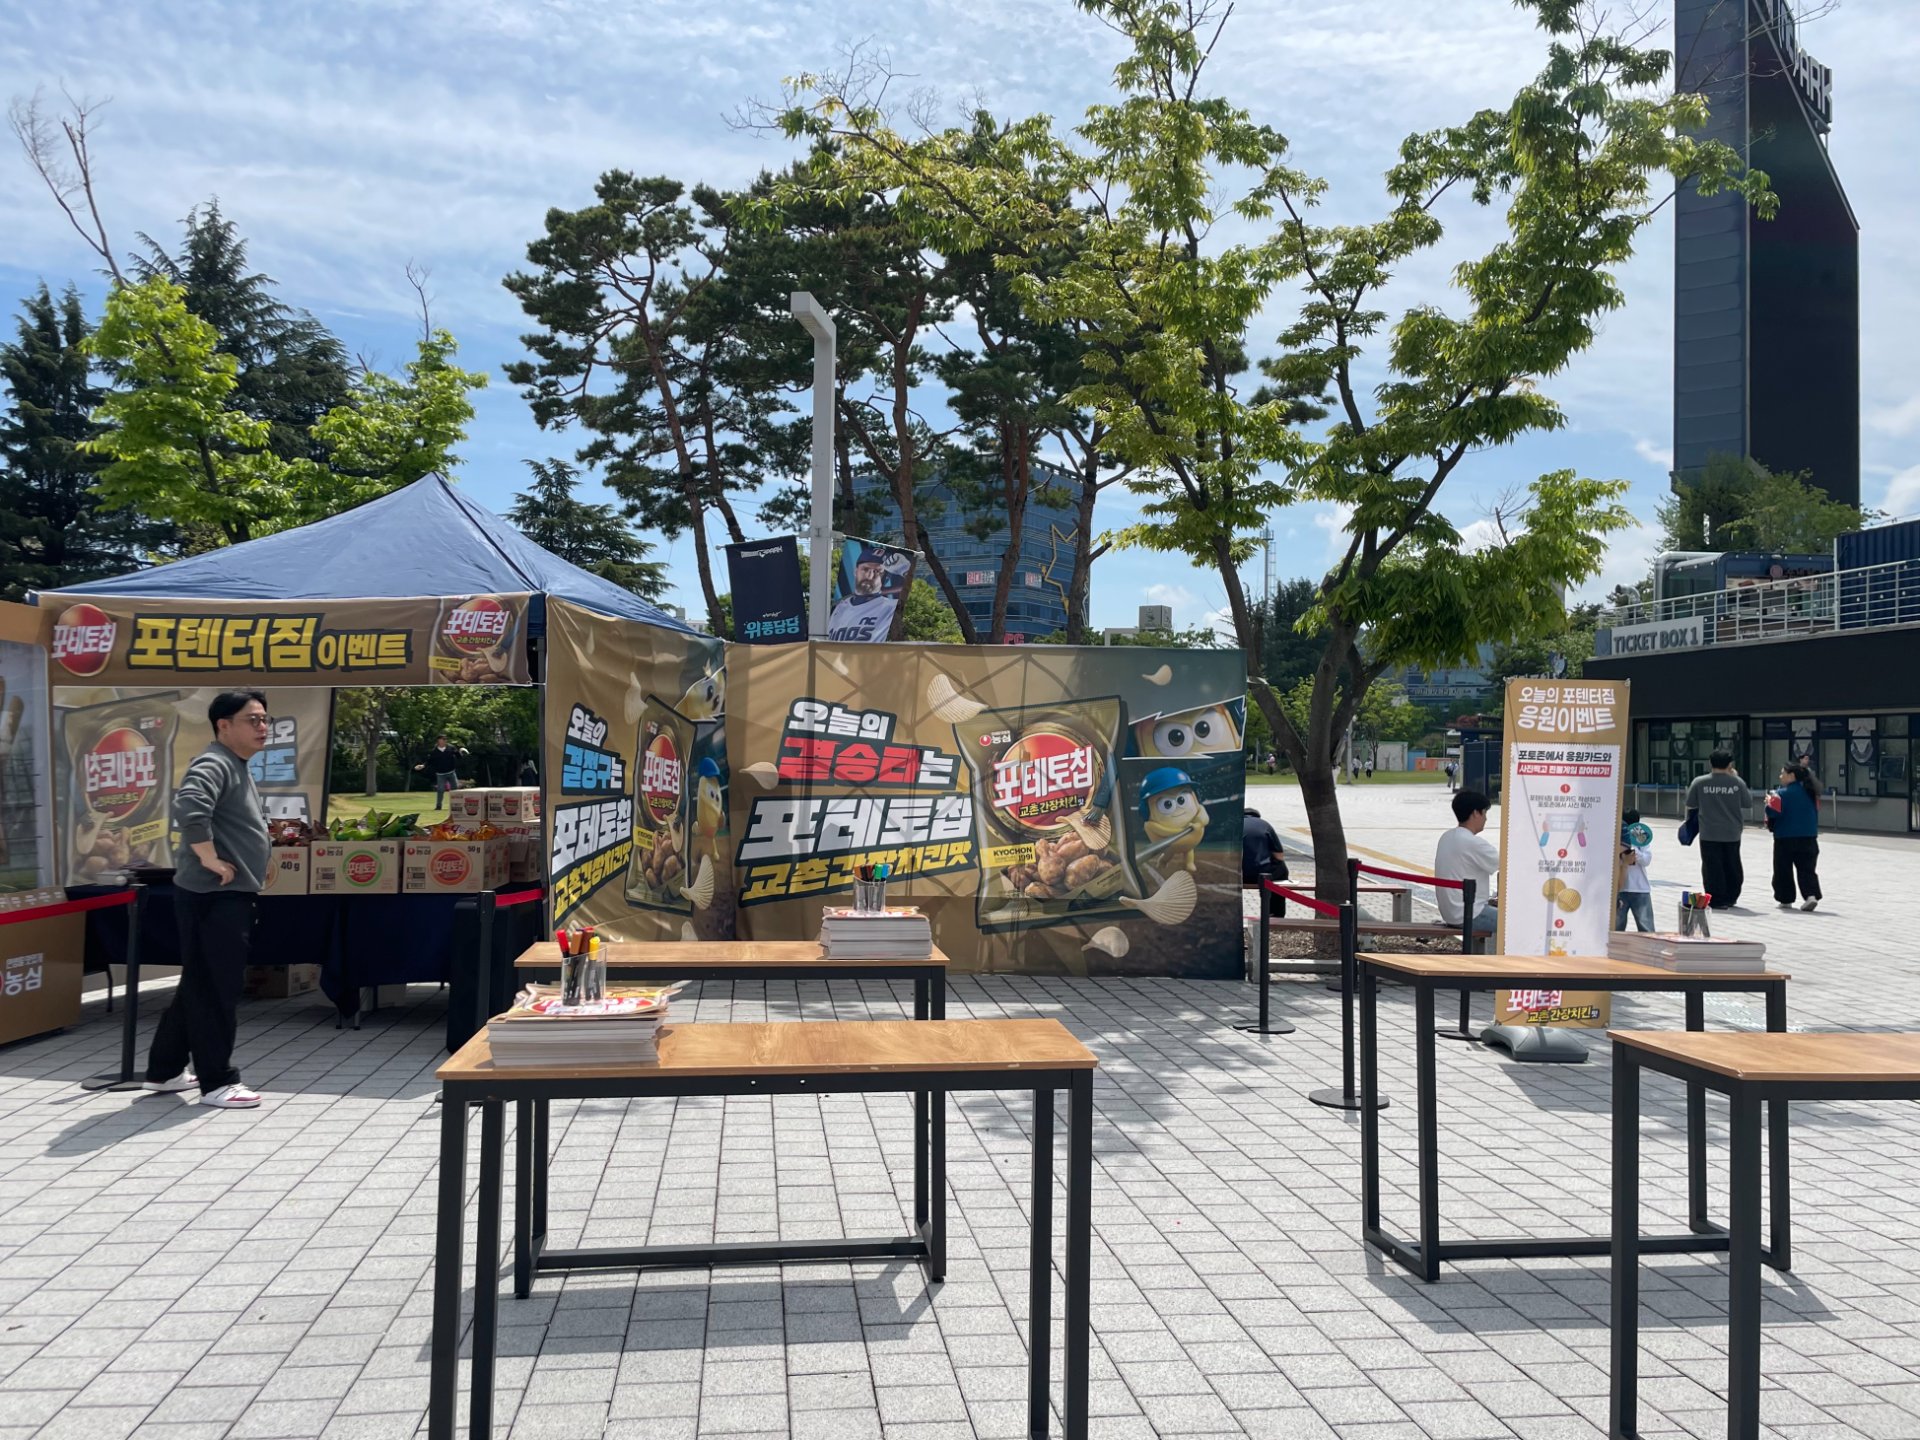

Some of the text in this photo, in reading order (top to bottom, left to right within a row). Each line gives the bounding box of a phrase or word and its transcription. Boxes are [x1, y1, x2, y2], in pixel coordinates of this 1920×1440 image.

[443, 609, 511, 634] 포테토칩
[744, 615, 800, 639] 위풍당당
[51, 622, 117, 659] 포테토칩
[130, 617, 407, 668] 포텐터짐 이벤트
[1614, 626, 1699, 653] TICKET BOX 1
[1518, 686, 1616, 705] 오늘의 포텐터짐
[568, 707, 606, 747] 오늘의
[788, 701, 889, 740] 오늘의
[1517, 705, 1616, 733] 응원이벤트
[562, 743, 623, 789] 결정구는
[778, 736, 953, 784] 결승타는
[1518, 750, 1612, 763] 포토존에서 응원카드와
[641, 750, 681, 795] 포테토칩
[993, 746, 1093, 808] 포테토칩
[1019, 804, 1039, 817] 교촌
[280, 861, 300, 872] 40 g
[993, 846, 1032, 857] KYOCHON
[5, 963, 43, 996] 농심
